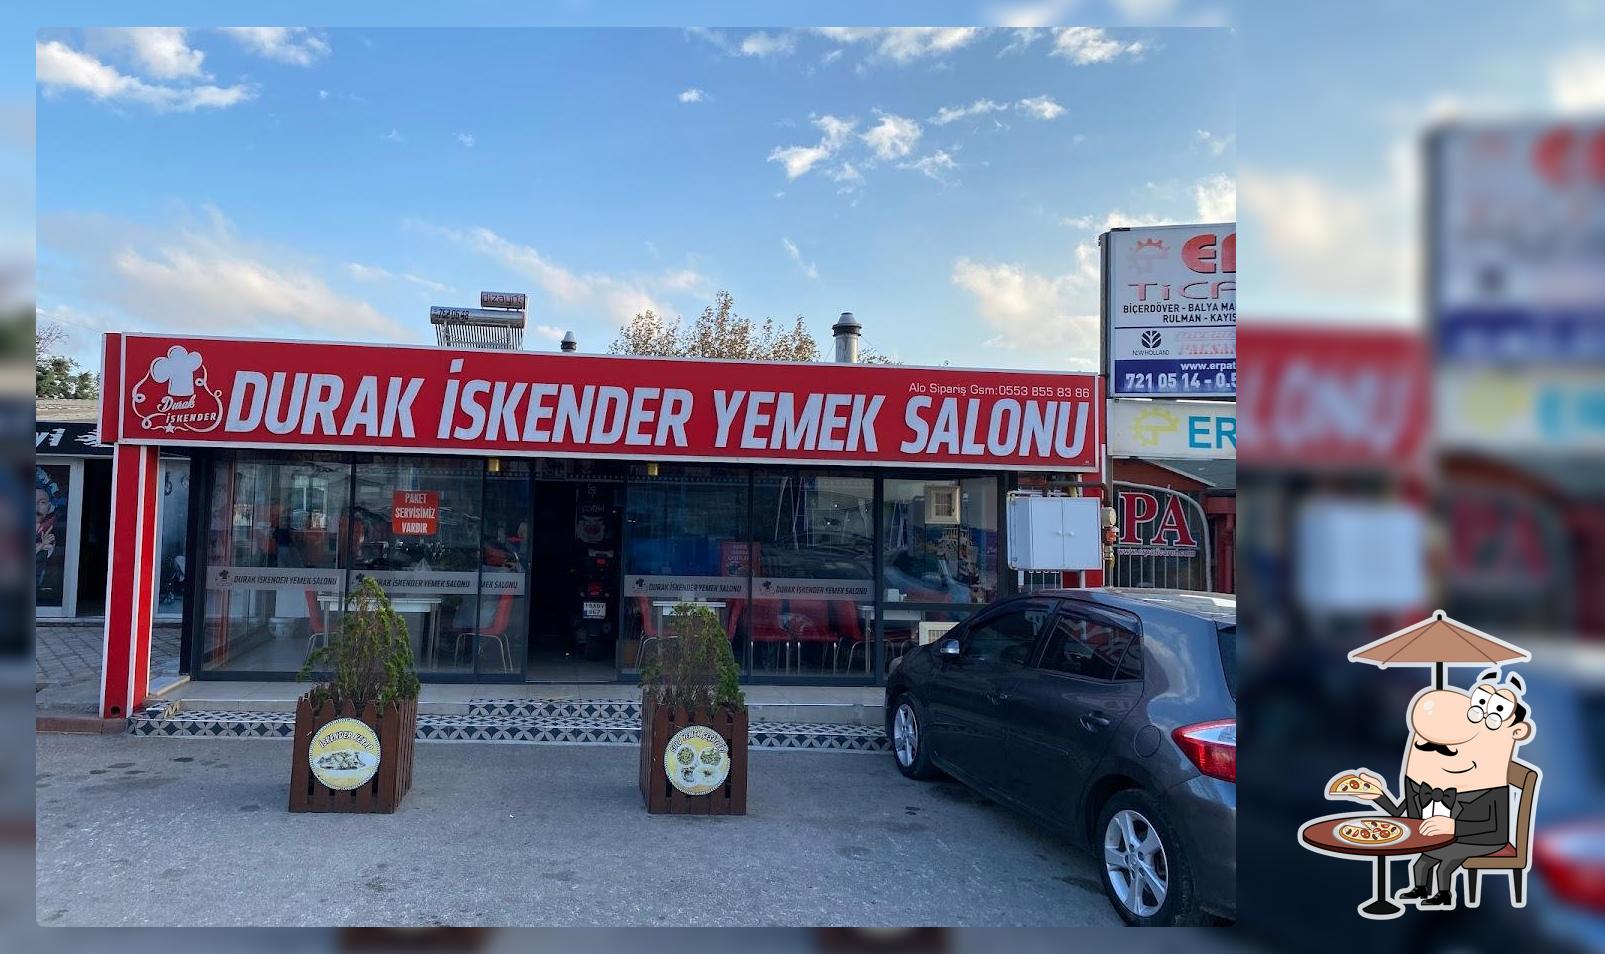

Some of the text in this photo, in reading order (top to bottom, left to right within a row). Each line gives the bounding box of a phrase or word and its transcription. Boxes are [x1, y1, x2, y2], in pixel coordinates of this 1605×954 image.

[1123, 302, 1180, 314] BİÇERDÖVER
[1188, 302, 1218, 312] BALYA
[1221, 302, 1236, 311] MA
[1163, 314, 1201, 323] RULMAN
[1125, 372, 1152, 389] 721
[1157, 372, 1177, 389] 05
[1182, 372, 1201, 388] 14
[908, 382, 926, 393] Alo
[929, 383, 967, 397] Sipariş
[1031, 386, 1054, 398] 855
[1057, 387, 1072, 398] 83
[1075, 387, 1090, 399] 86
[157, 394, 197, 412] Durak
[224, 358, 1090, 460] DURAK İSKENDER YEMEK SALONU
[1188, 416, 1236, 449] ER
[405, 492, 428, 504] PAKET
[394, 506, 436, 519] SERVİSİMİZ
[1119, 491, 1198, 547] PA
[401, 522, 428, 534] VARDIR
[233, 575, 256, 584] DURAK
[289, 576, 312, 585] YEMEK
[312, 577, 338, 586] SALONU
[424, 579, 446, 588] YEMEK
[446, 580, 471, 588] SALONU
[494, 580, 518, 589] SALONU
